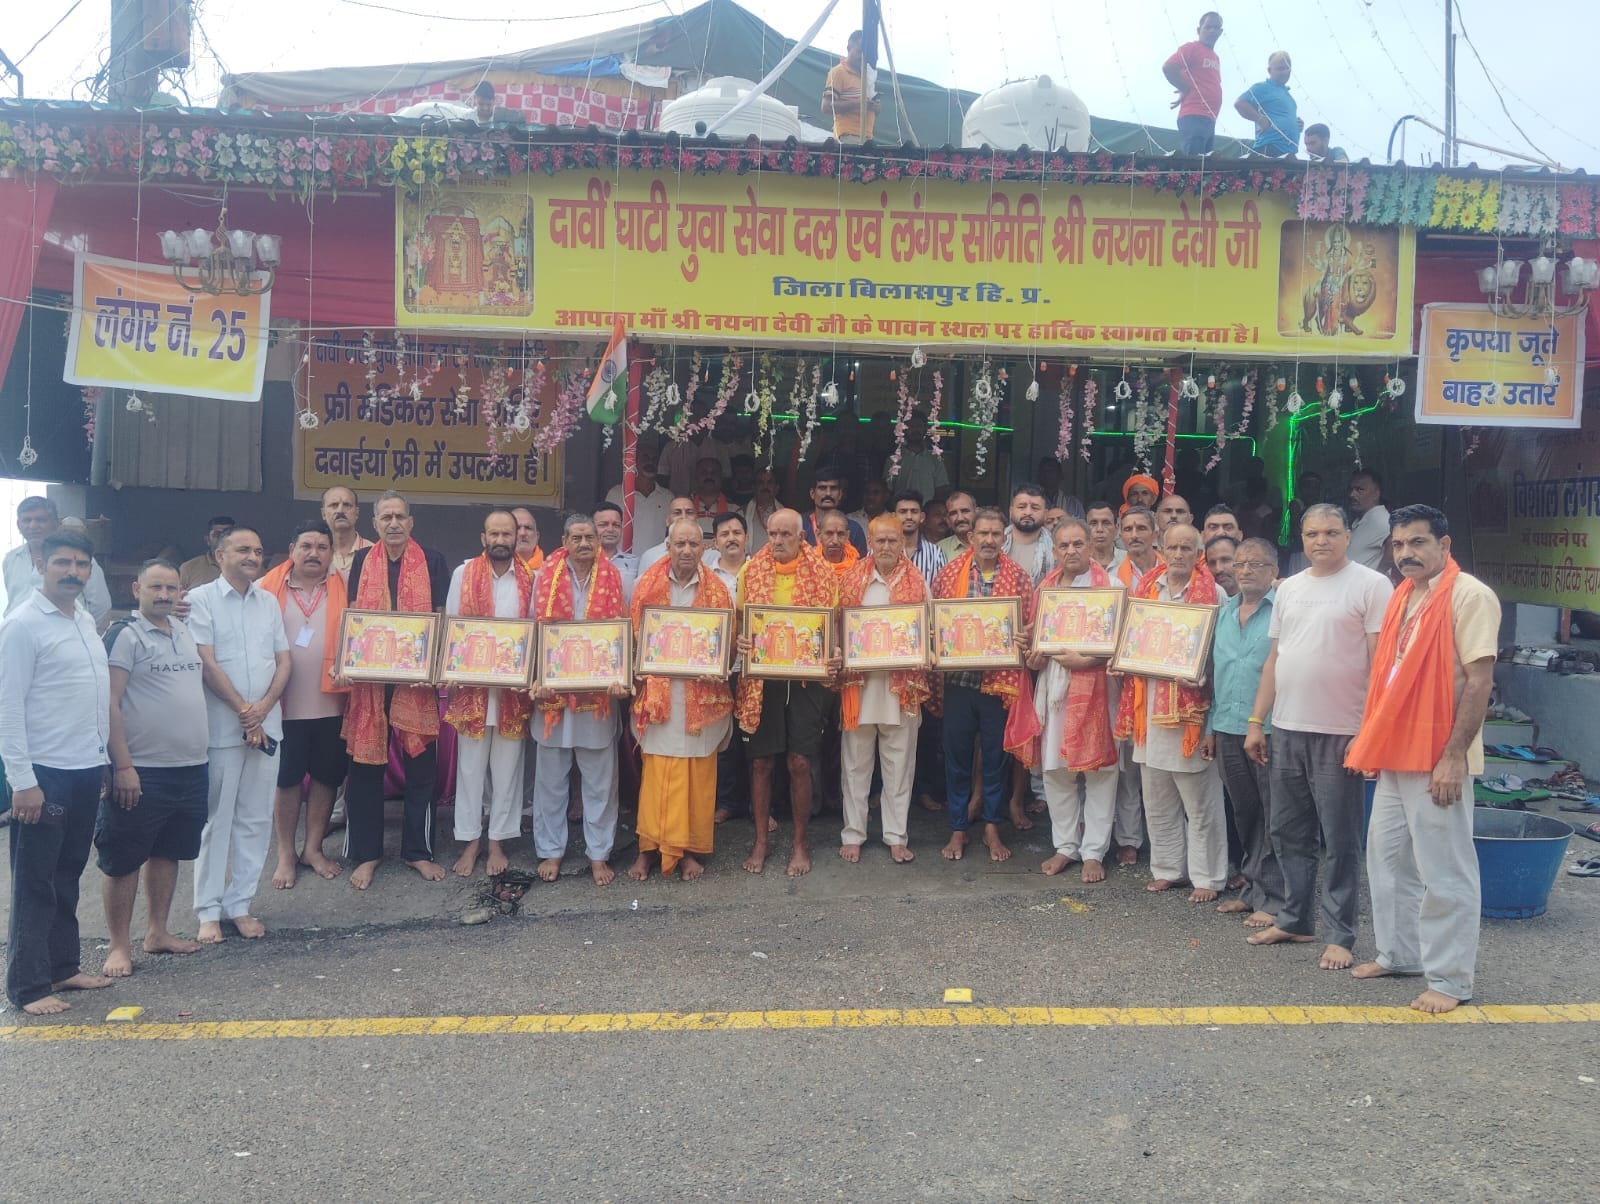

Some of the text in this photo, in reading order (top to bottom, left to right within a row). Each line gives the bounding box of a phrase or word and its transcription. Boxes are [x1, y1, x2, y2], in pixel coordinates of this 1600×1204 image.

[549, 177, 1261, 282] दावीं घाटी युवा सेवा दल एवं लंगर समिति श्री नयना देवी जी
[773, 276, 845, 298] जिला
[850, 278, 971, 307] बिलासपुर
[94, 288, 160, 353] लंगर
[208, 309, 246, 362] 25
[671, 309, 701, 330] श्री
[704, 314, 768, 332] नयना
[773, 311, 813, 334] देवी
[817, 313, 847, 334] जी
[851, 314, 873, 334] के
[878, 319, 936, 337] पावन
[940, 321, 990, 338] स्थल
[994, 322, 1024, 339] पर
[1027, 319, 1096, 340] हार्दिक
[1100, 324, 1168, 342] स्वागत
[1172, 327, 1231, 343] करता
[1446, 324, 1560, 366] कृपया जूते
[324, 381, 352, 424] फ्री
[314, 436, 388, 481] दवाईयां
[392, 438, 419, 481] फ्री
[424, 440, 446, 478] में
[448, 452, 519, 481] उपलब्ध
[1571, 532, 1588, 548] पर
